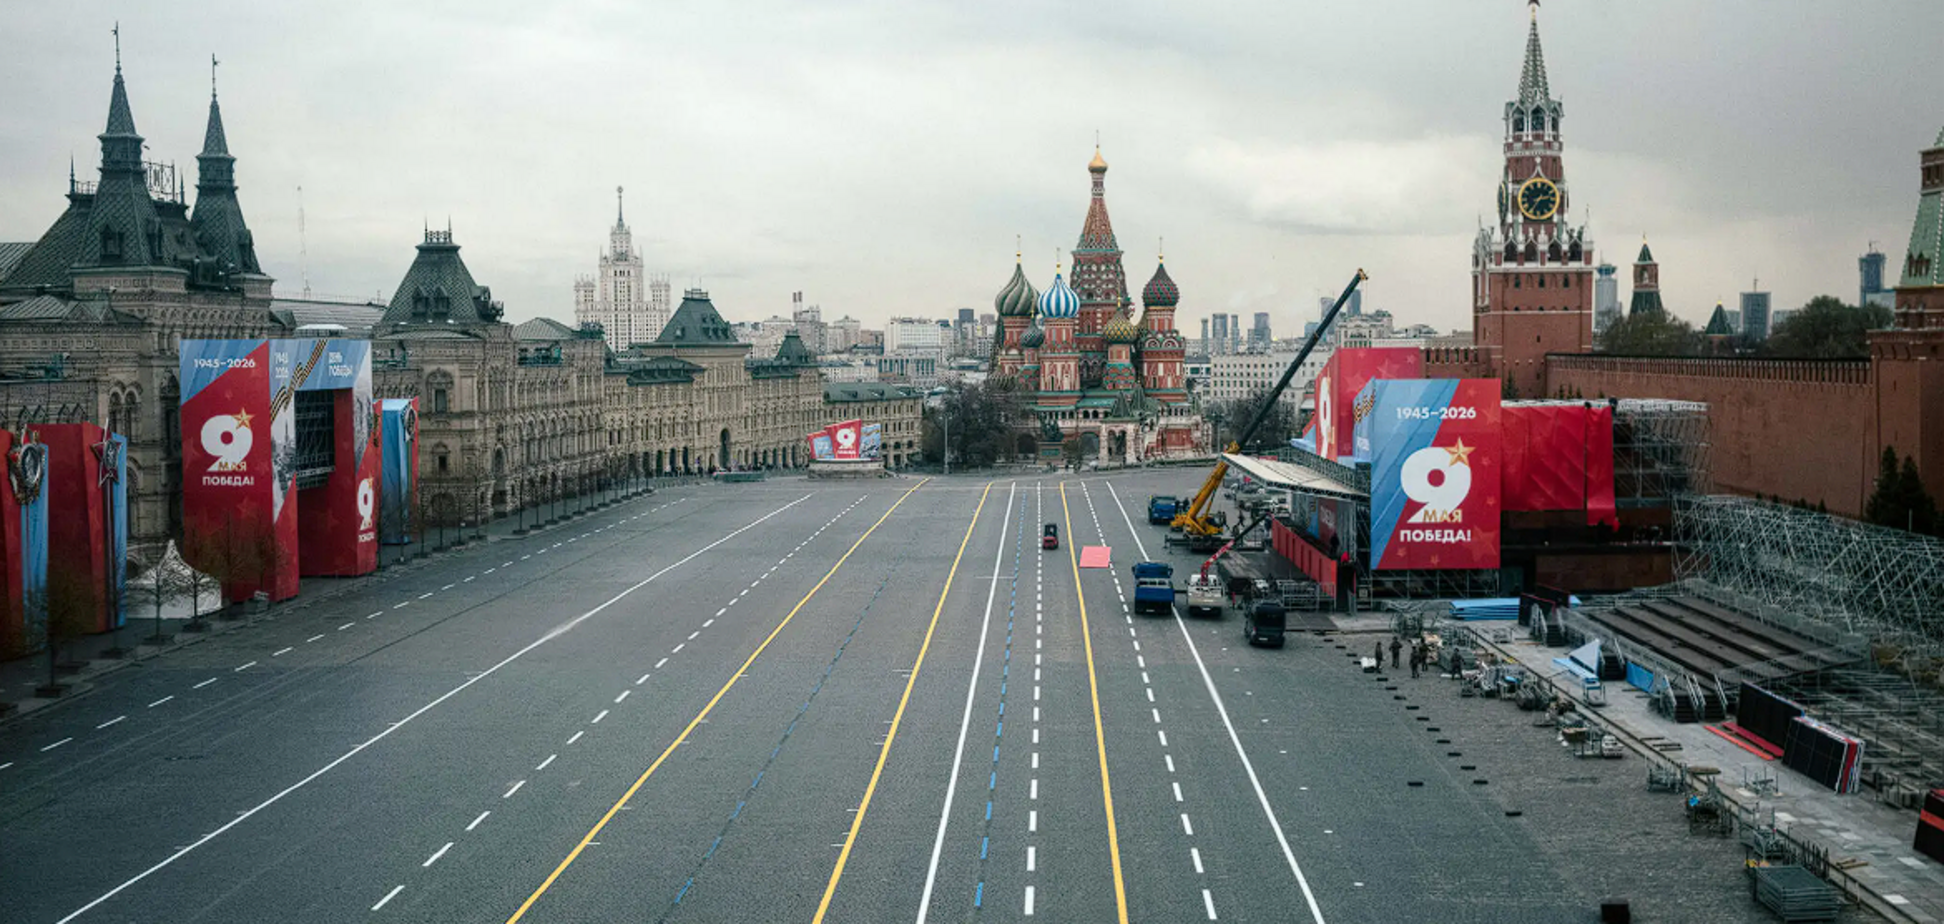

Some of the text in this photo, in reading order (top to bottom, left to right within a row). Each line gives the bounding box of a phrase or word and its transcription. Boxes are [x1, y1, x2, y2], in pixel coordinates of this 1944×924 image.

[201, 415, 253, 471] 9
[837, 428, 856, 450] 9
[218, 461, 247, 471] МАЯ
[202, 476, 254, 487] ПОБЕДА!
[1401, 447, 1471, 523] 9
[358, 478, 374, 530] 9
[1424, 509, 1462, 523] МАЯ
[1400, 530, 1471, 543] ПОБЕДА!
